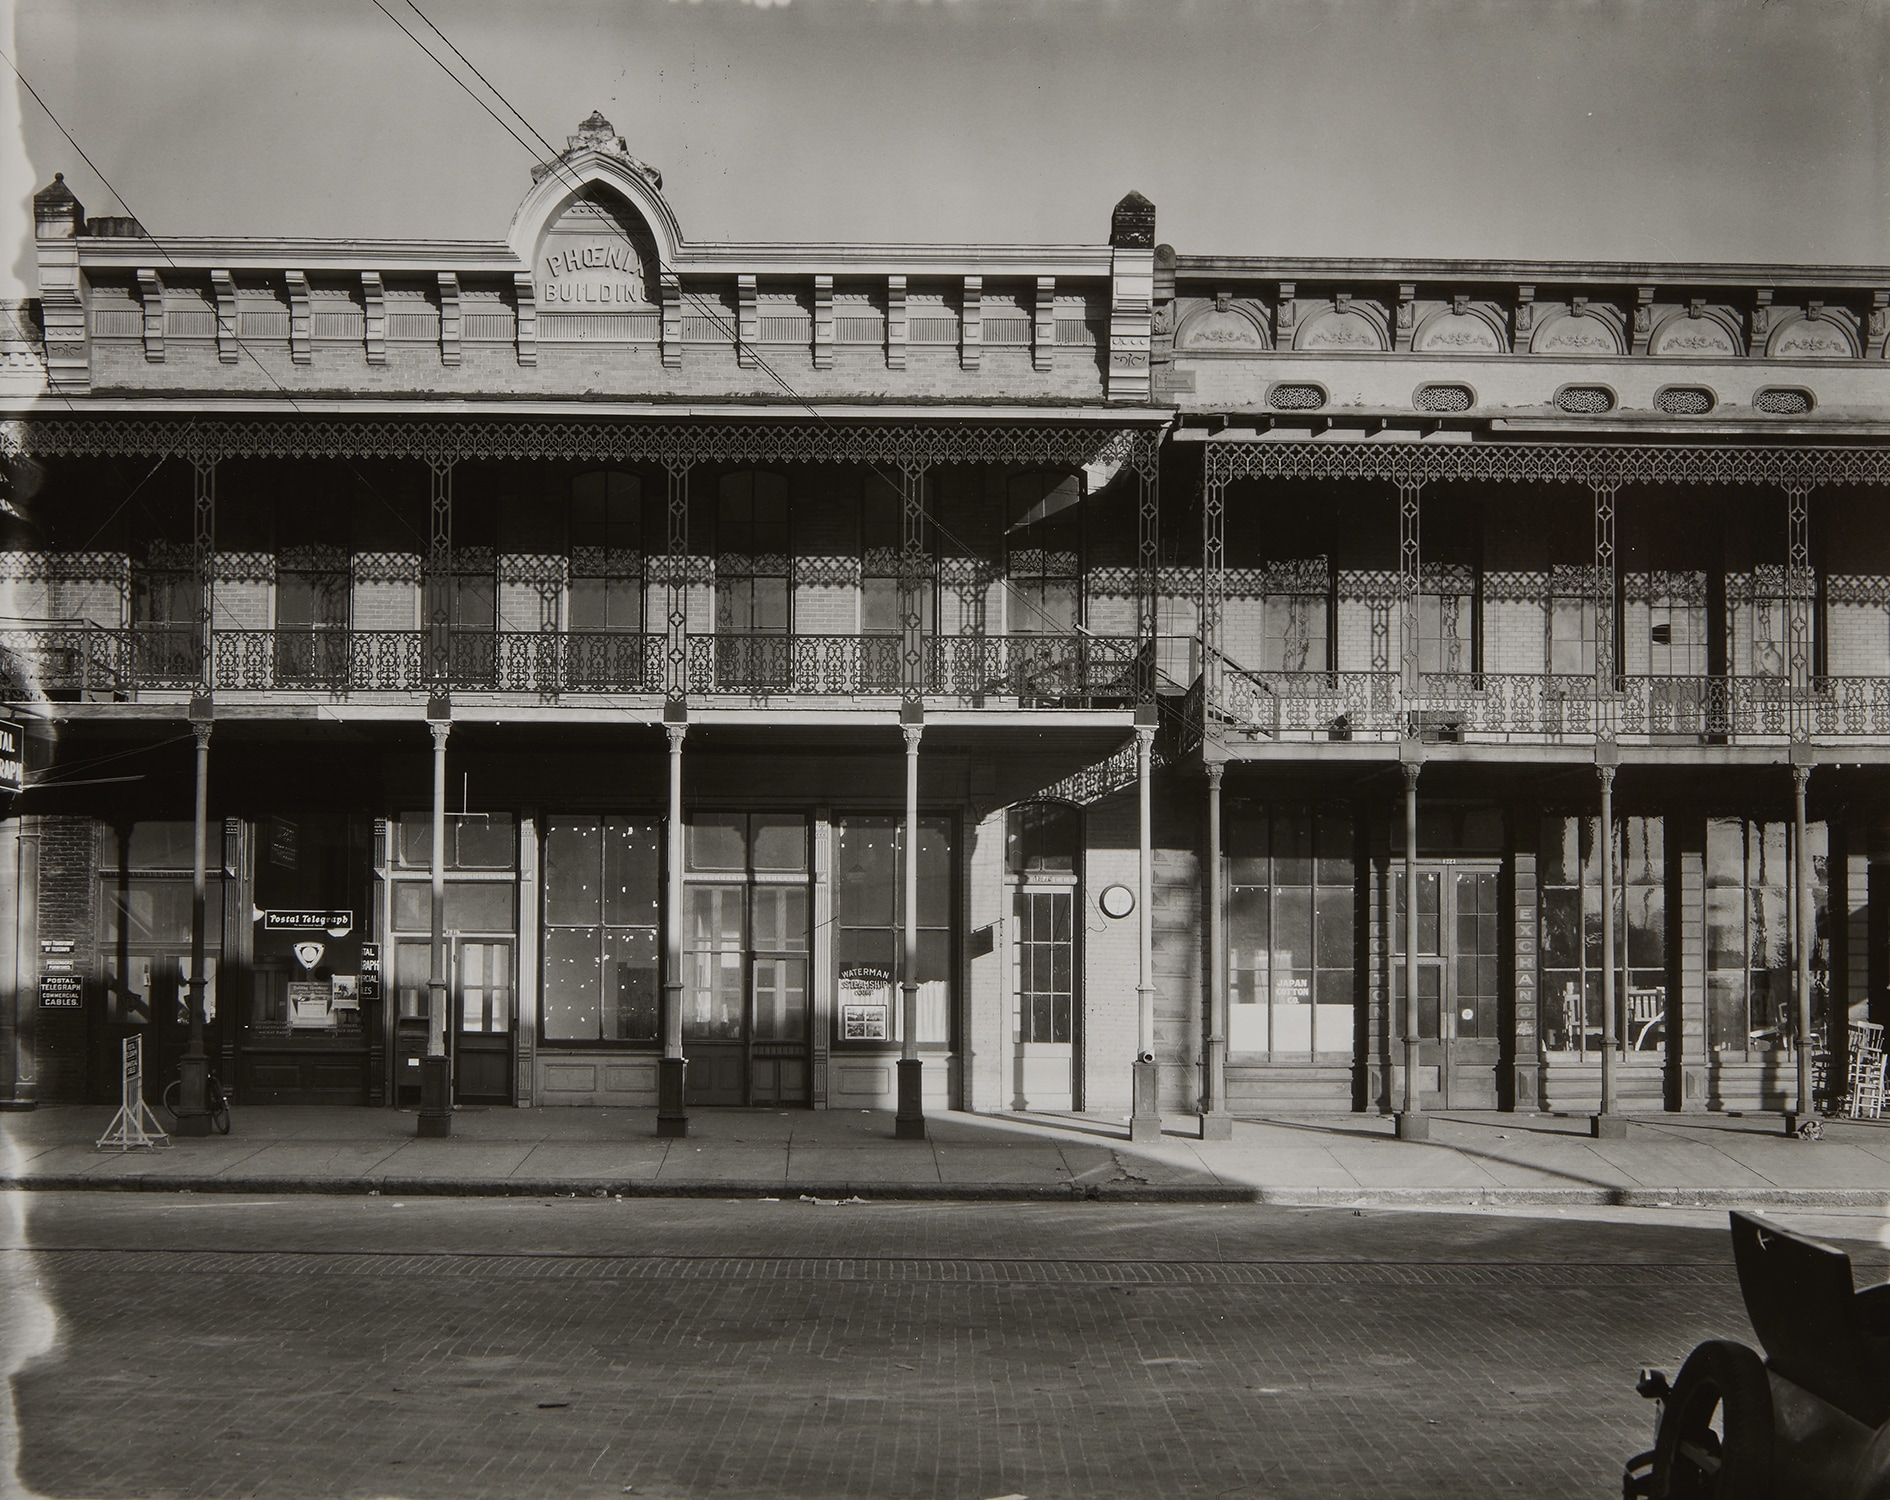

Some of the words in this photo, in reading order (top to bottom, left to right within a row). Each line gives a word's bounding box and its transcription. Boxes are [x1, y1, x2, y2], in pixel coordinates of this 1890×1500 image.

[545, 283, 655, 303] BUILDING
[269, 914, 300, 924] Postal
[302, 914, 349, 926] Telegraph
[841, 967, 890, 979] WATERMAN
[1518, 909, 1533, 1036] EXCHANG
[841, 980, 889, 990] STEAMSHIP
[1277, 979, 1308, 988] JAPAN
[1276, 987, 1309, 996] COTTON
